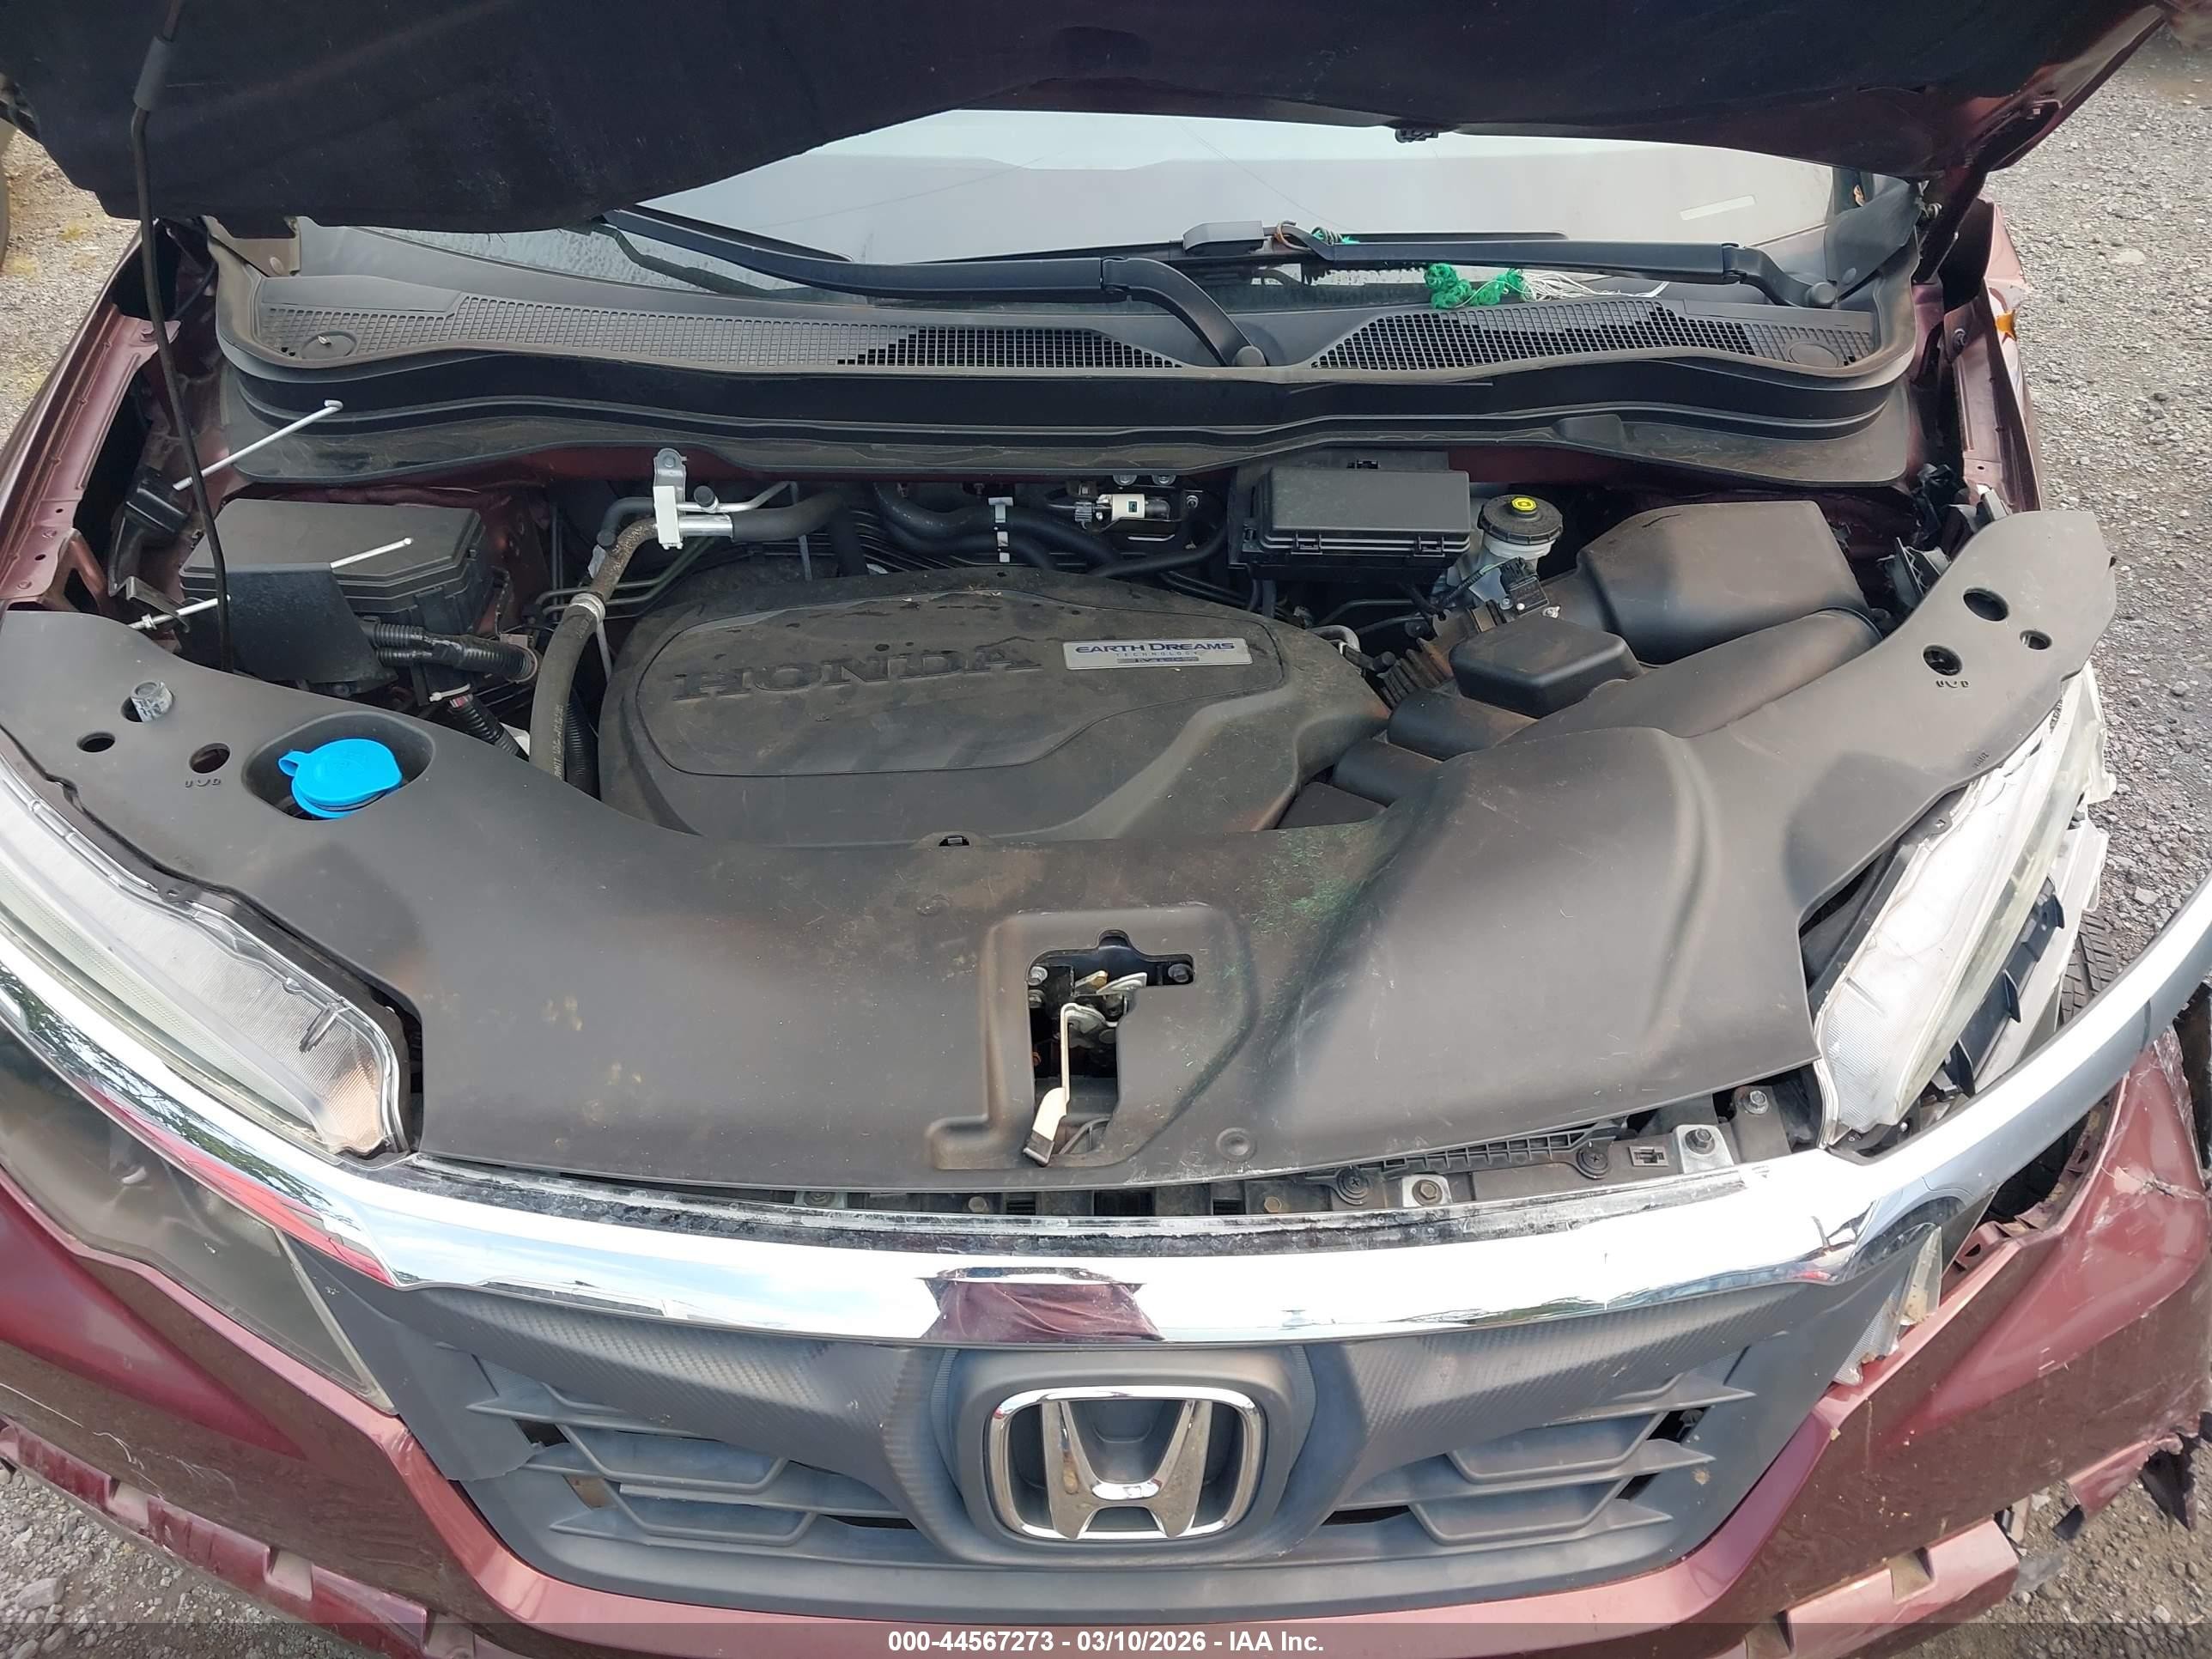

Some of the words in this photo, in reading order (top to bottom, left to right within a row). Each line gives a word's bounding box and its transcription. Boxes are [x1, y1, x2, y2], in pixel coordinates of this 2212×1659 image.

[1075, 645, 1145, 653] EARTH
[1149, 642, 1236, 652] DREAMS
[672, 650, 1044, 701] HONDA
